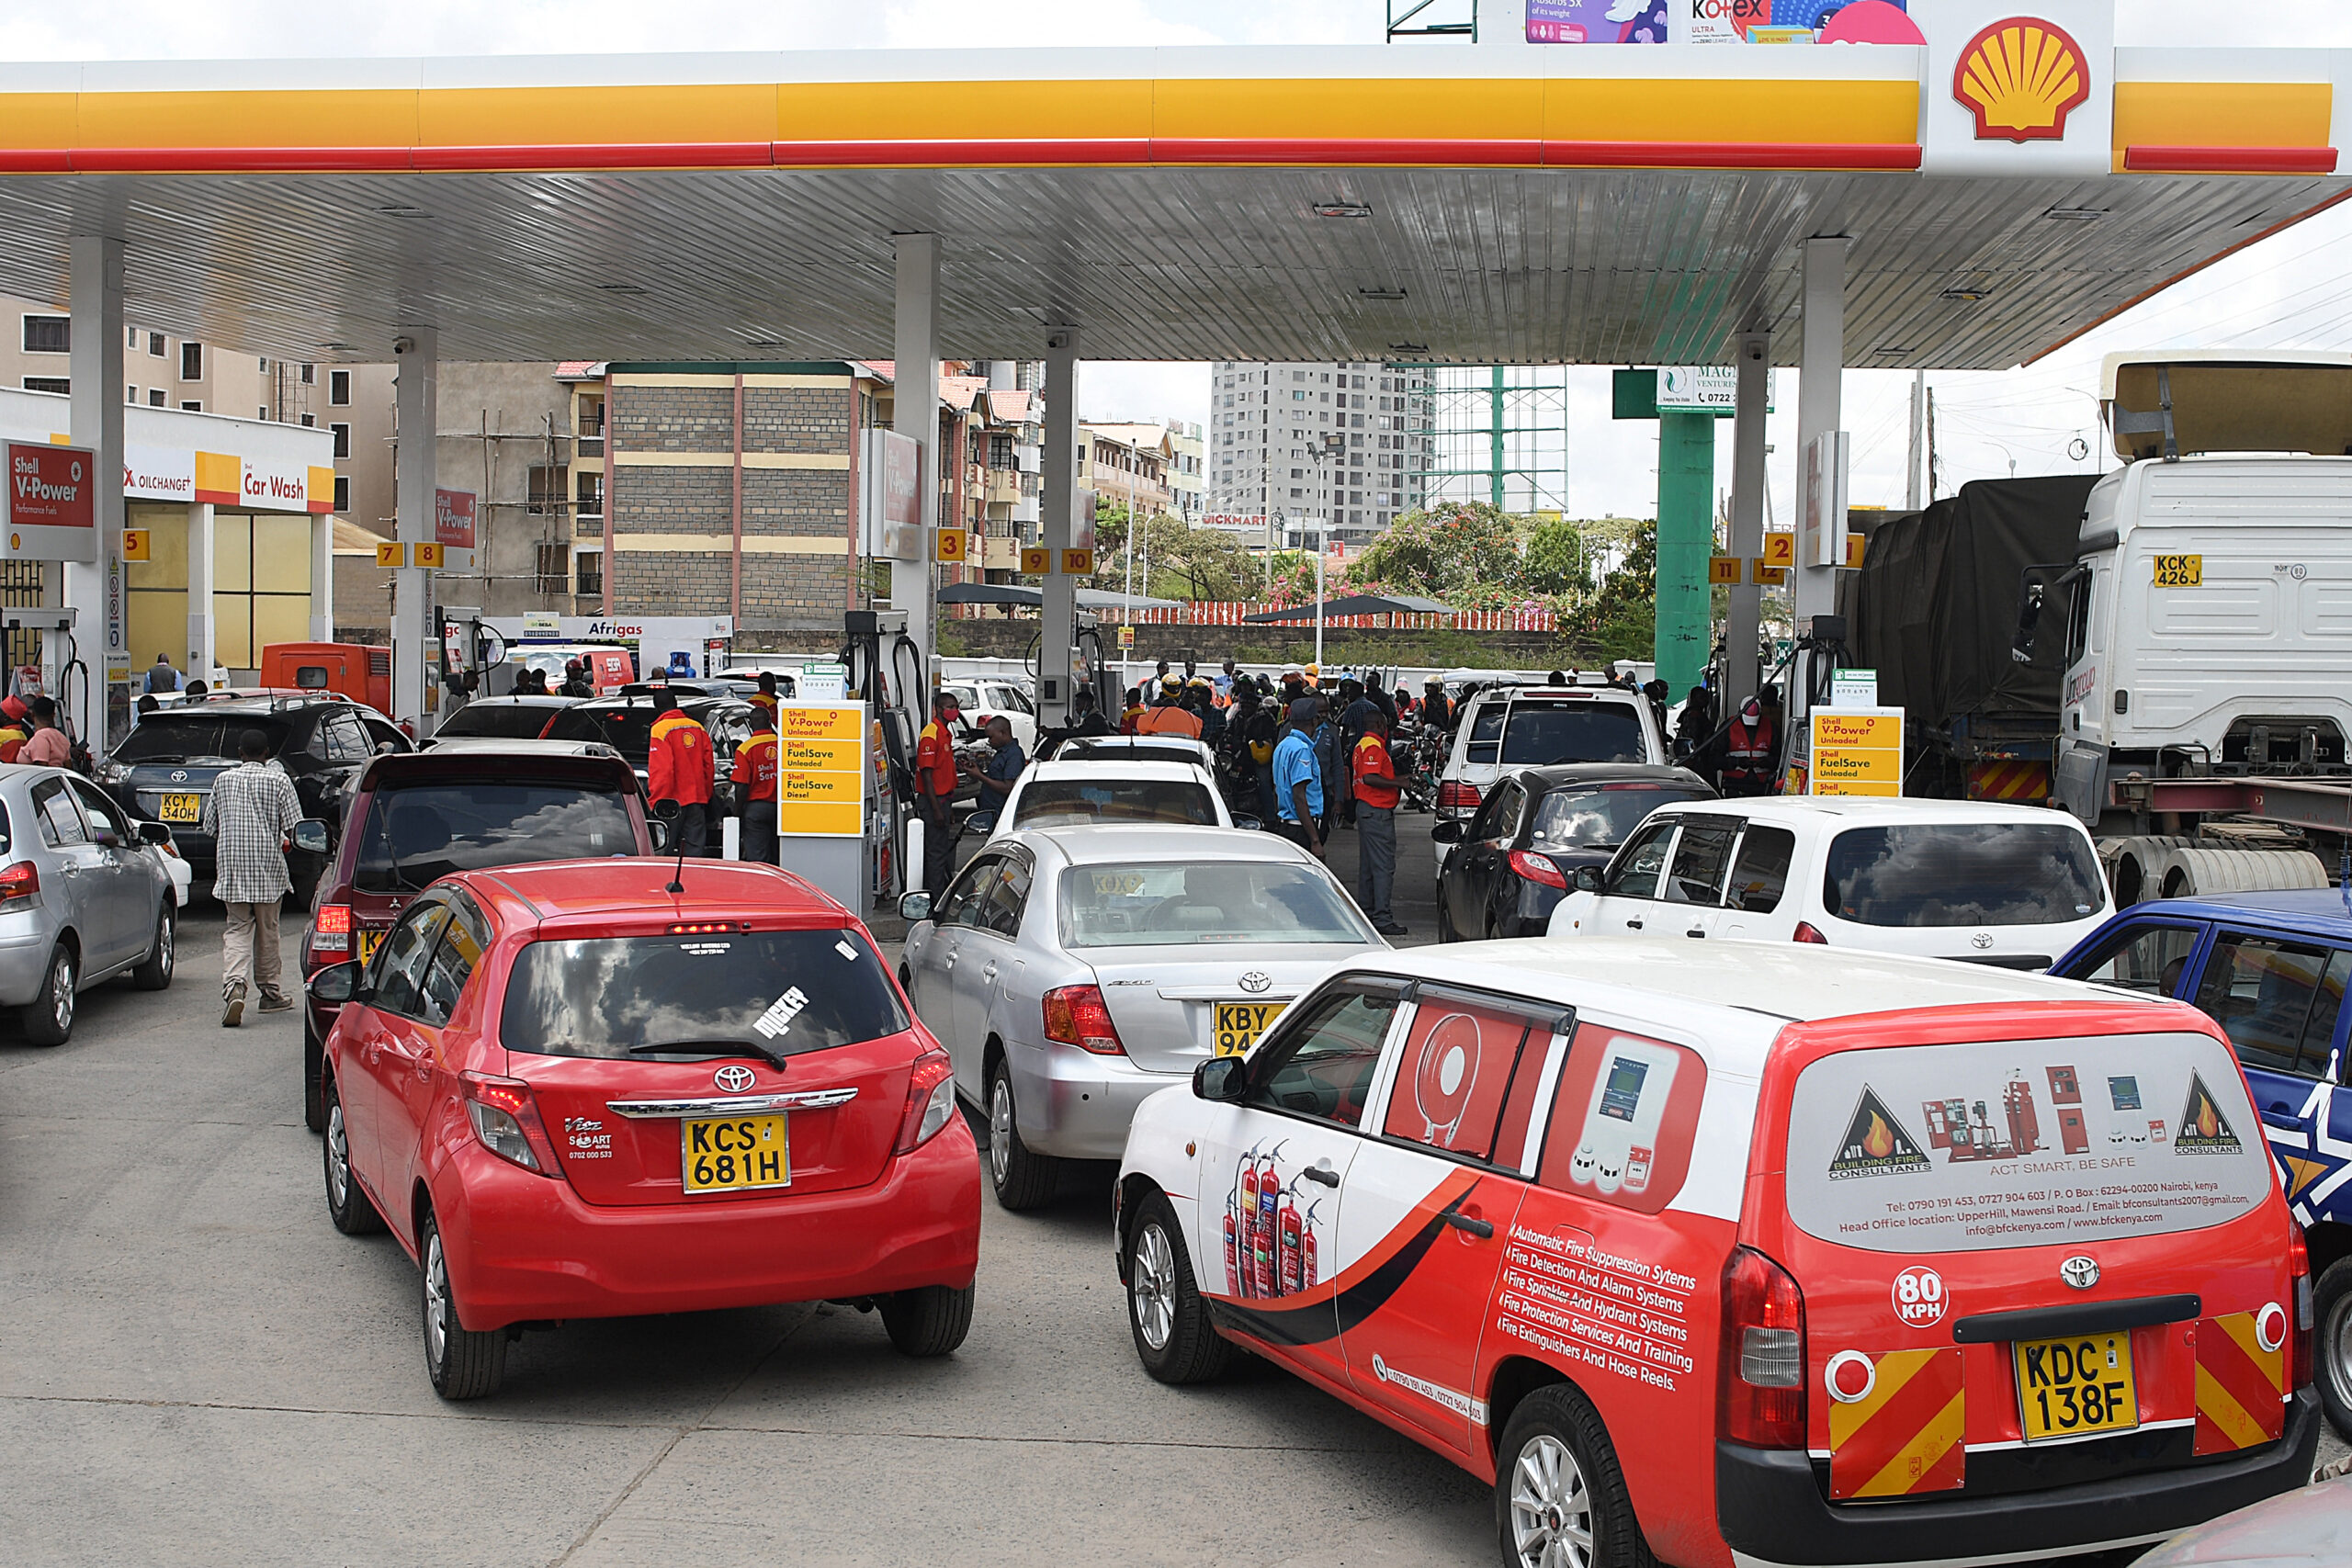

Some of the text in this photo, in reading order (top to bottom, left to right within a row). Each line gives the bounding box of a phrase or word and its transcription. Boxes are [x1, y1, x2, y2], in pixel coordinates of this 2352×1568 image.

[1549, 10, 1570, 18] weight
[1708, 393, 1730, 402] 0722
[15, 457, 39, 474] Shell
[16, 476, 77, 502] V-Power
[244, 472, 304, 500] Car Wash
[16, 503, 57, 514] Performance Fuels
[437, 496, 451, 507] Shell
[437, 508, 471, 529] V-Power
[126, 533, 137, 550] 5
[943, 536, 957, 555] 3
[1774, 538, 1789, 558] 2
[383, 547, 393, 560] 7
[424, 547, 433, 560] 8
[1030, 553, 1042, 569] 9
[1069, 553, 1086, 569] 10
[1719, 562, 1732, 578] 11
[1760, 562, 1778, 577] 12
[2157, 556, 2188, 570] KCK
[2157, 570, 2199, 585] 426J
[589, 620, 642, 637] Afrigas
[789, 718, 834, 728] V-Power
[1822, 726, 1871, 735] V-Power
[787, 749, 833, 758] FuelSave
[1820, 758, 1871, 768] FuelSave
[787, 781, 833, 790] FuelSave
[164, 795, 188, 807] KCY
[163, 807, 196, 819] 340H
[752, 985, 809, 1039] MICKEY
[1219, 1007, 1268, 1031] KBY
[1220, 1032, 1262, 1055] 94
[692, 1122, 756, 1154] KCS
[2177, 1137, 2237, 1146] BUILDING FIRE
[2175, 1145, 2244, 1154] CONSULTANTS
[695, 1150, 779, 1184] 681H
[1828, 1163, 1932, 1179] CONSULTANTS
[1834, 1155, 1923, 1170] BUILDING FIRE
[1990, 1156, 2136, 1176] ACT SMART, BE SAFE
[1886, 1202, 1905, 1213] Tel:
[1907, 1200, 1935, 1211] 0790
[1937, 1198, 1952, 1208] 191
[1954, 1196, 1976, 1207] 453,
[1978, 1194, 2003, 1205] 0727
[2005, 1192, 2025, 1202] 904
[2028, 1190, 2045, 1201] 603
[2100, 1183, 2159, 1195] 62294-00200
[2161, 1181, 2193, 1192] Nairobi,
[2195, 1180, 2219, 1192] kenya
[1839, 1221, 1870, 1233] Head
[1871, 1218, 1906, 1230] Office
[1908, 1214, 1955, 1227] location:
[1957, 1208, 2008, 1224] UpperHill,
[2011, 1207, 2055, 1218] Mawensi
[2092, 1200, 2120, 1212] Email:
[1965, 1221, 2064, 1236] info@bfckenya.com
[2074, 1213, 2163, 1228] www.bfckenya.com
[1514, 1224, 1696, 1290] Automatic Fire Suppression Sytems
[1511, 1247, 1683, 1314] Fire Detection And Alarm Systems
[1898, 1272, 1941, 1303] 80
[1508, 1270, 1687, 1342] Fire Sprinkler And Hydrant Systems
[1902, 1303, 1940, 1319] KPH
[1503, 1296, 1693, 1373] Fire Protection Services And Training
[1501, 1318, 1677, 1392] Fire Extinguishers And Hose Reels.
[2025, 1341, 2098, 1388] KDC
[1393, 1371, 1409, 1386] 0790
[1410, 1379, 1420, 1391] 191
[1437, 1391, 1453, 1406] 0727
[1454, 1399, 1468, 1413] 904
[2037, 1381, 2125, 1431] 138F
